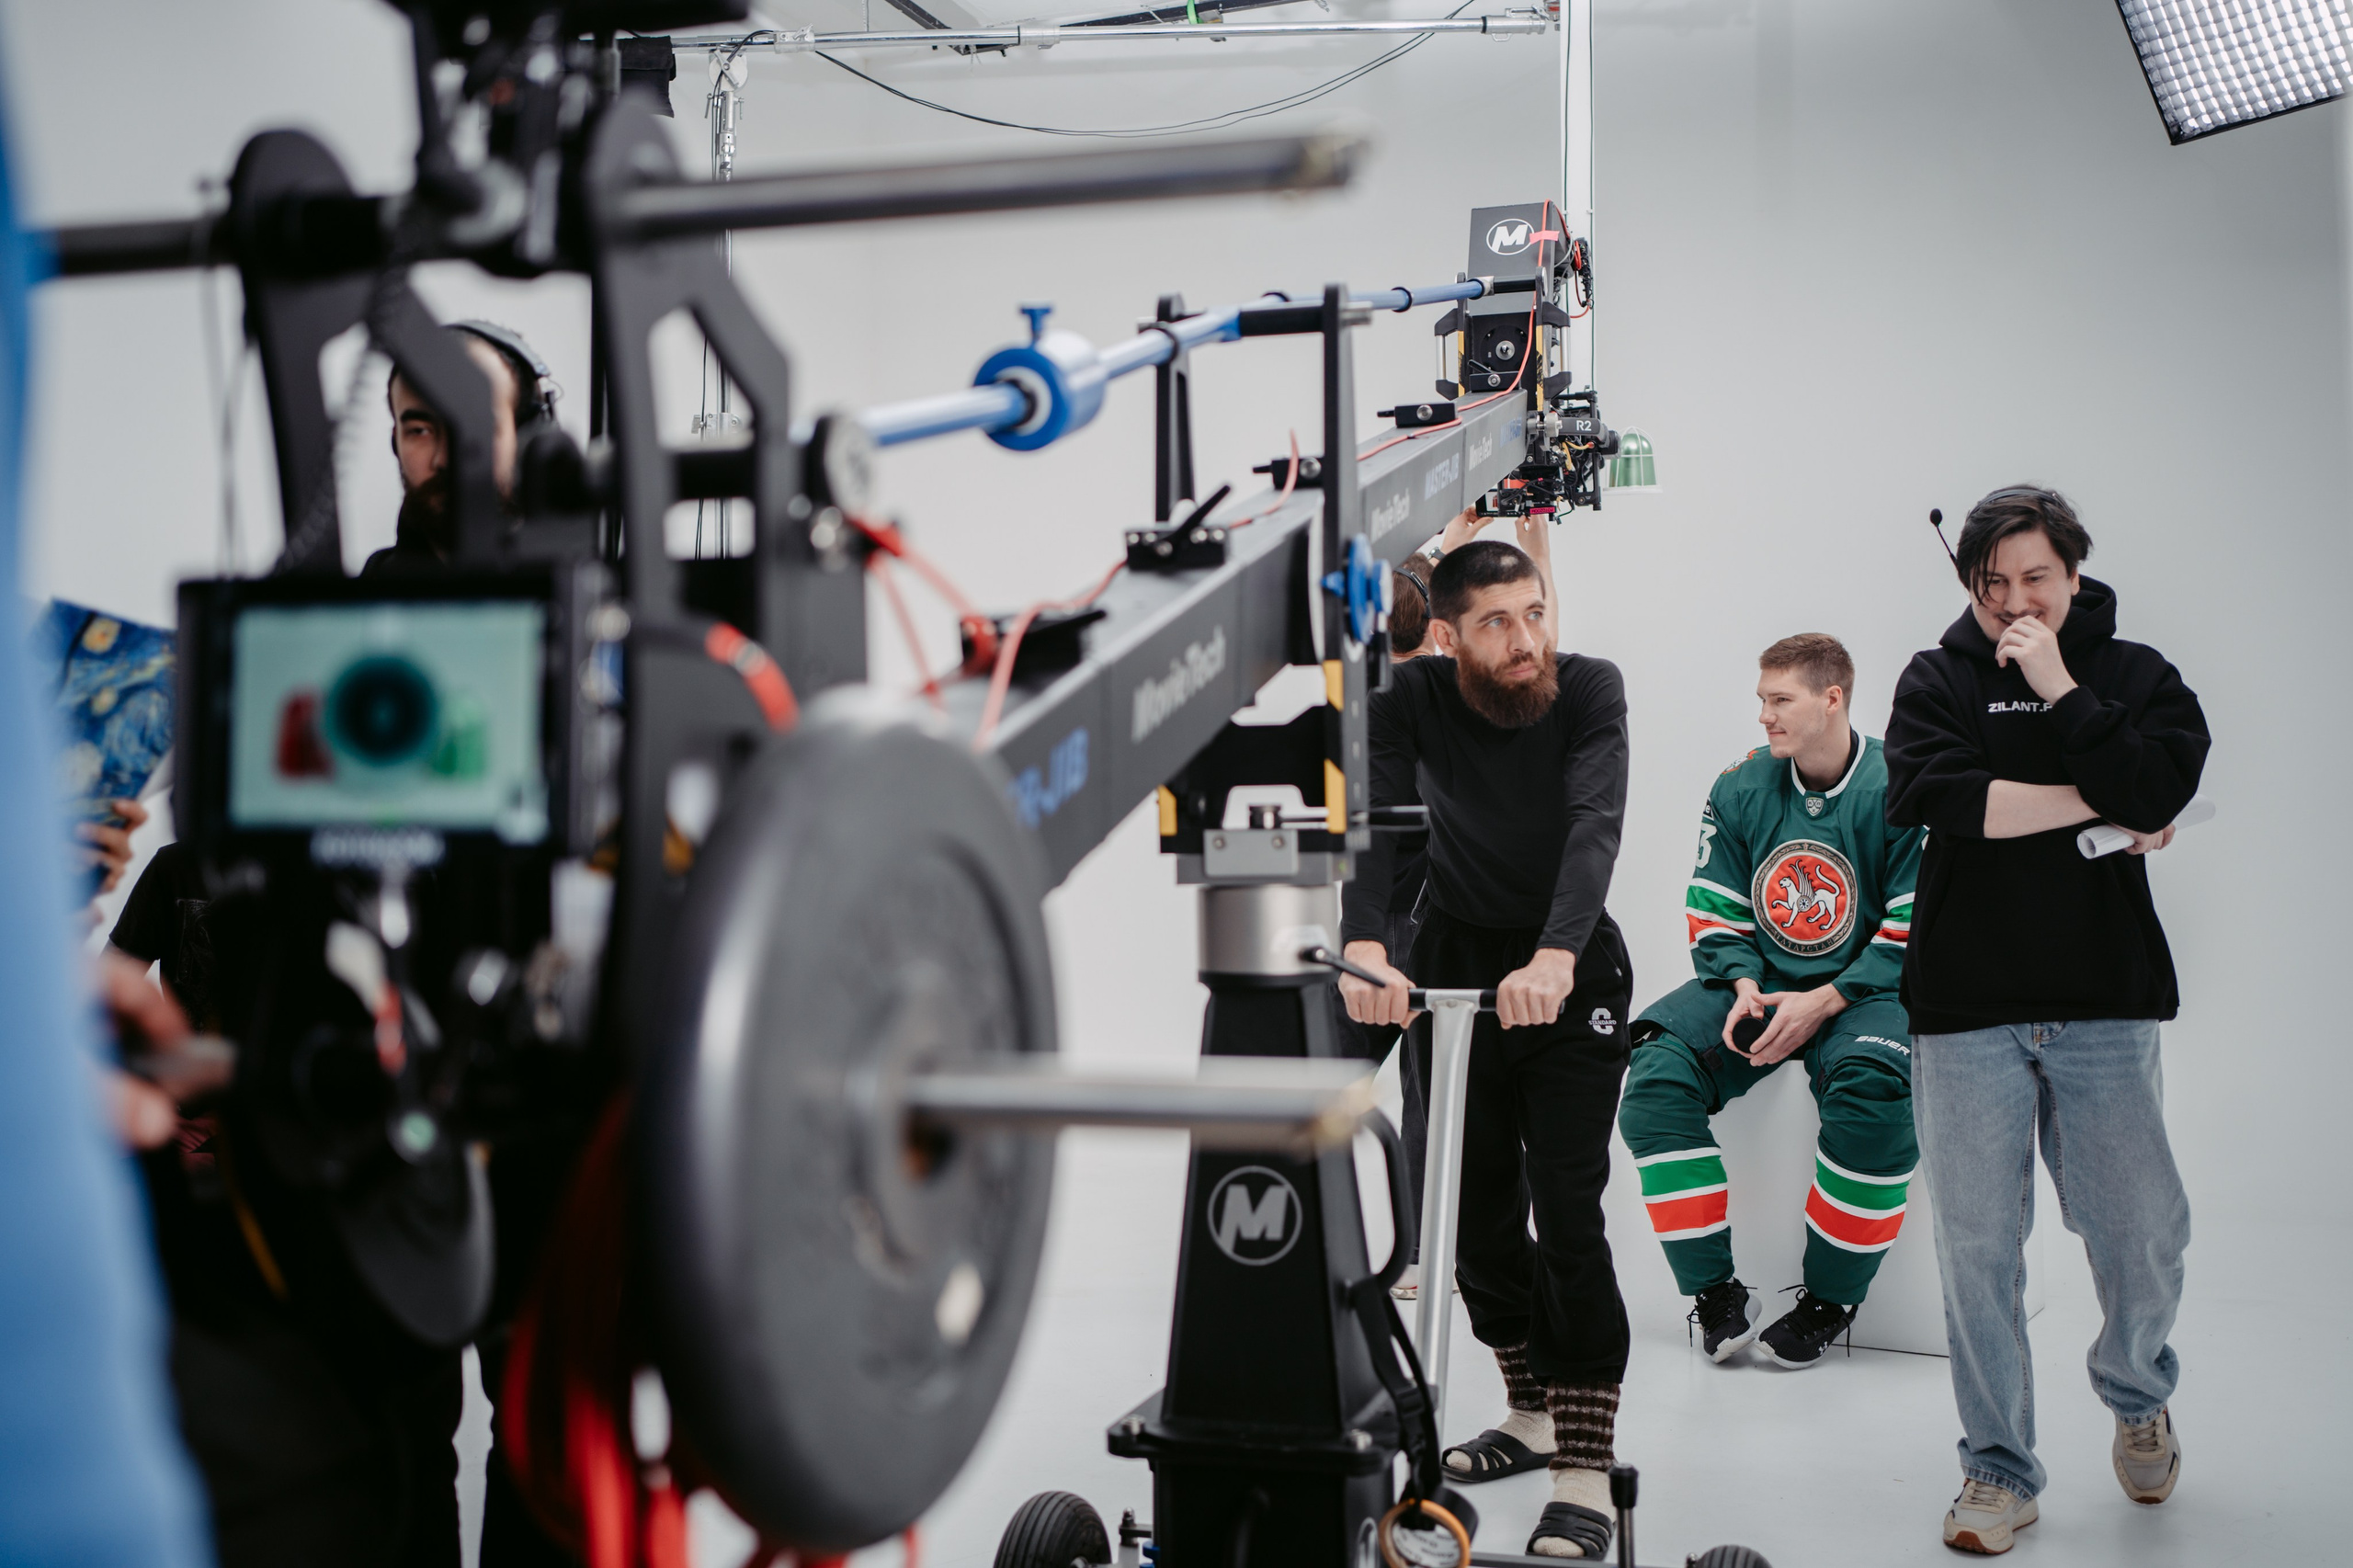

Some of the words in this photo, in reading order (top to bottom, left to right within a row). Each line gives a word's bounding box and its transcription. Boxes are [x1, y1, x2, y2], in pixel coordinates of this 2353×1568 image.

[1576, 420, 1592, 431] R2
[1469, 431, 1493, 472] MovieTech
[1775, 931, 1836, 952] ТАТАРСТАН
[1855, 1035, 1911, 1056] BAUER
